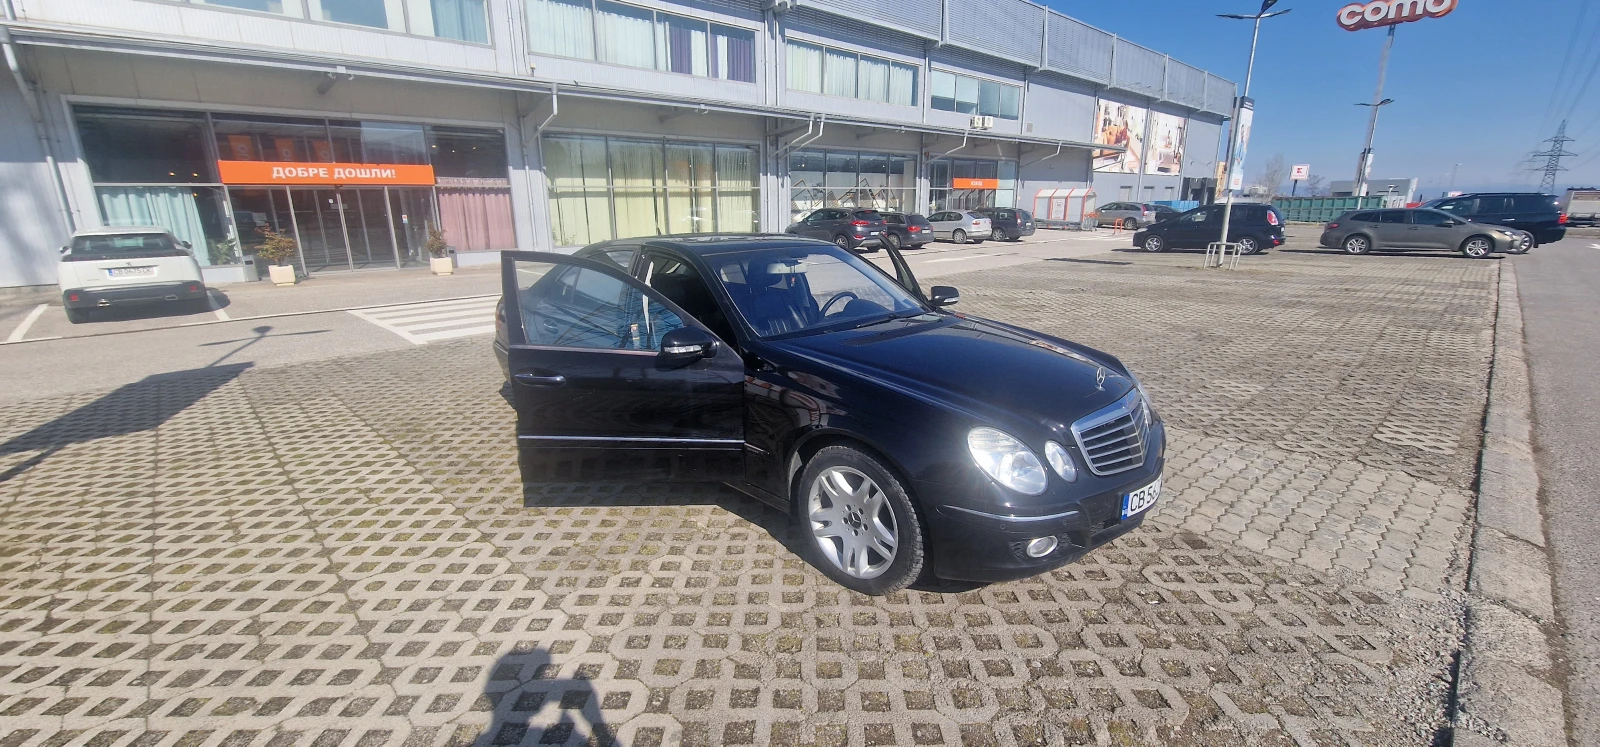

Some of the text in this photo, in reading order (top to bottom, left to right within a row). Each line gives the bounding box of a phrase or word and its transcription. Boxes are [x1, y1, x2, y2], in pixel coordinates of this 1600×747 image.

[1340, 0, 1449, 25] como
[272, 166, 396, 179] ДОБРЕ ДОШЛИ!
[1130, 490, 1145, 512] CB
